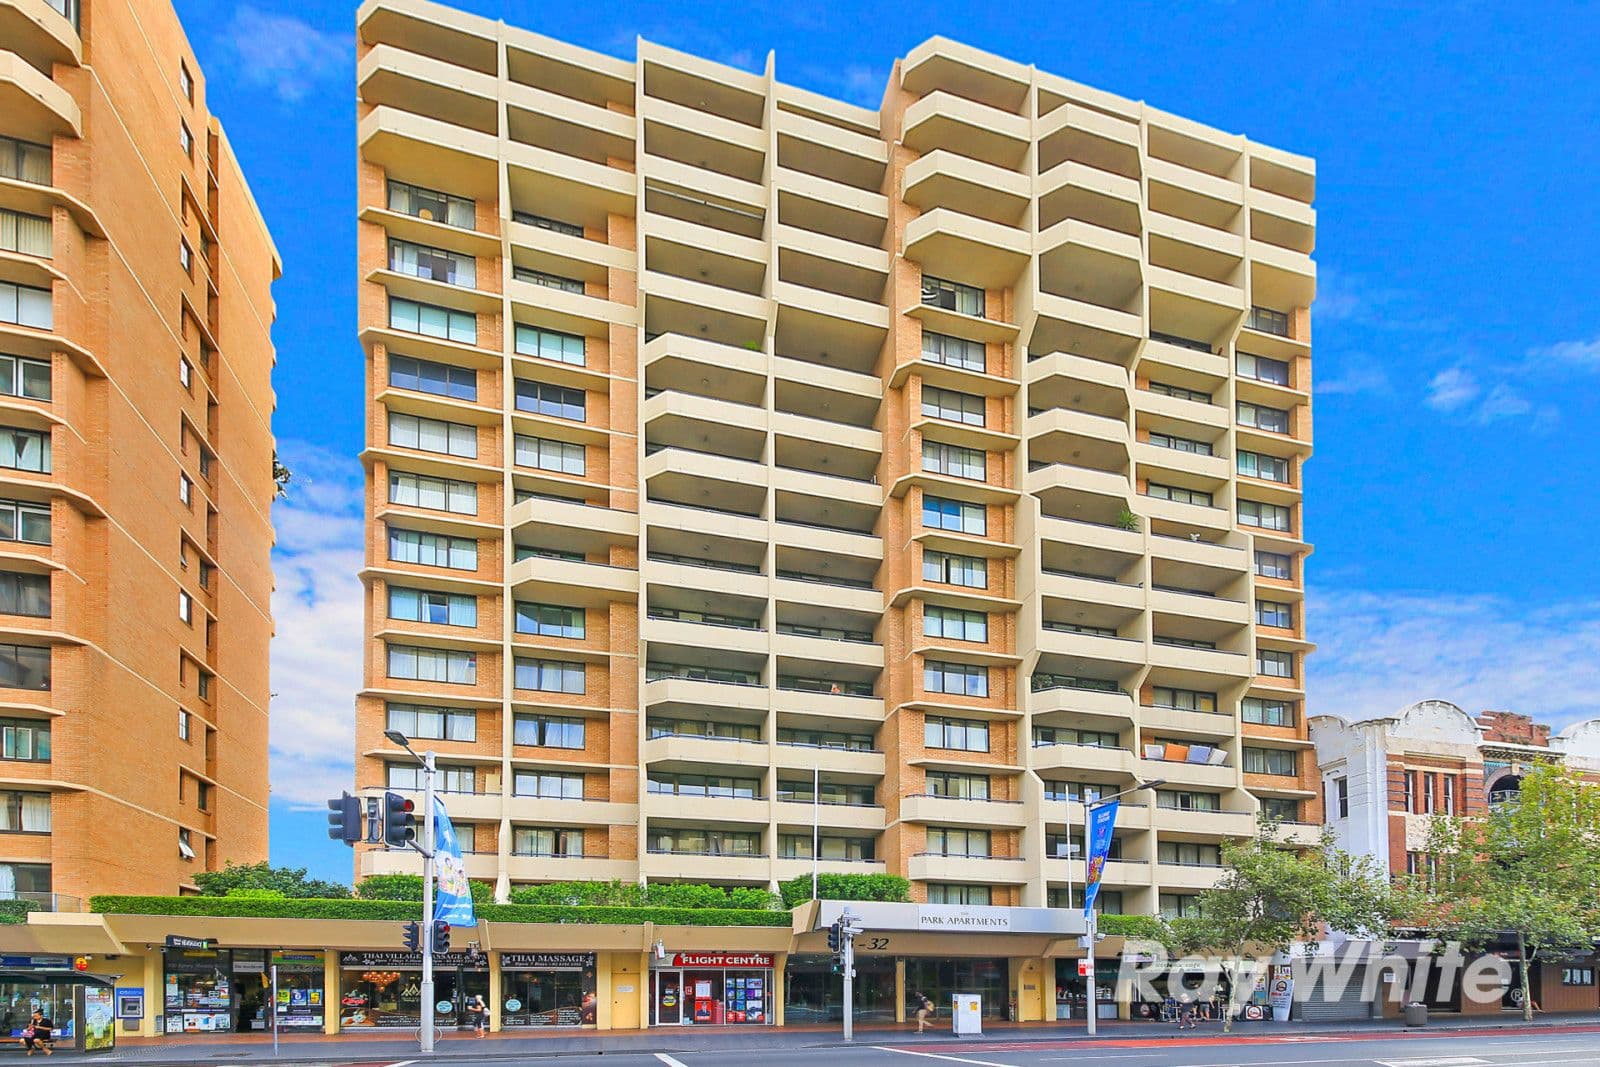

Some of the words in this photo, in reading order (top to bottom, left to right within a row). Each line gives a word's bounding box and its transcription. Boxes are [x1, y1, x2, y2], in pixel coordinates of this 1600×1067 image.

[920, 916, 945, 925] PARK
[948, 917, 1009, 926] APARTMENTS
[361, 952, 384, 960] THAI
[384, 952, 423, 960] VILLAGE
[424, 952, 464, 960] ASSAGE
[511, 954, 536, 963] THAI
[537, 954, 587, 963] MASSAGE
[681, 956, 724, 965] FLIGHT
[725, 956, 770, 965] CENTRE
